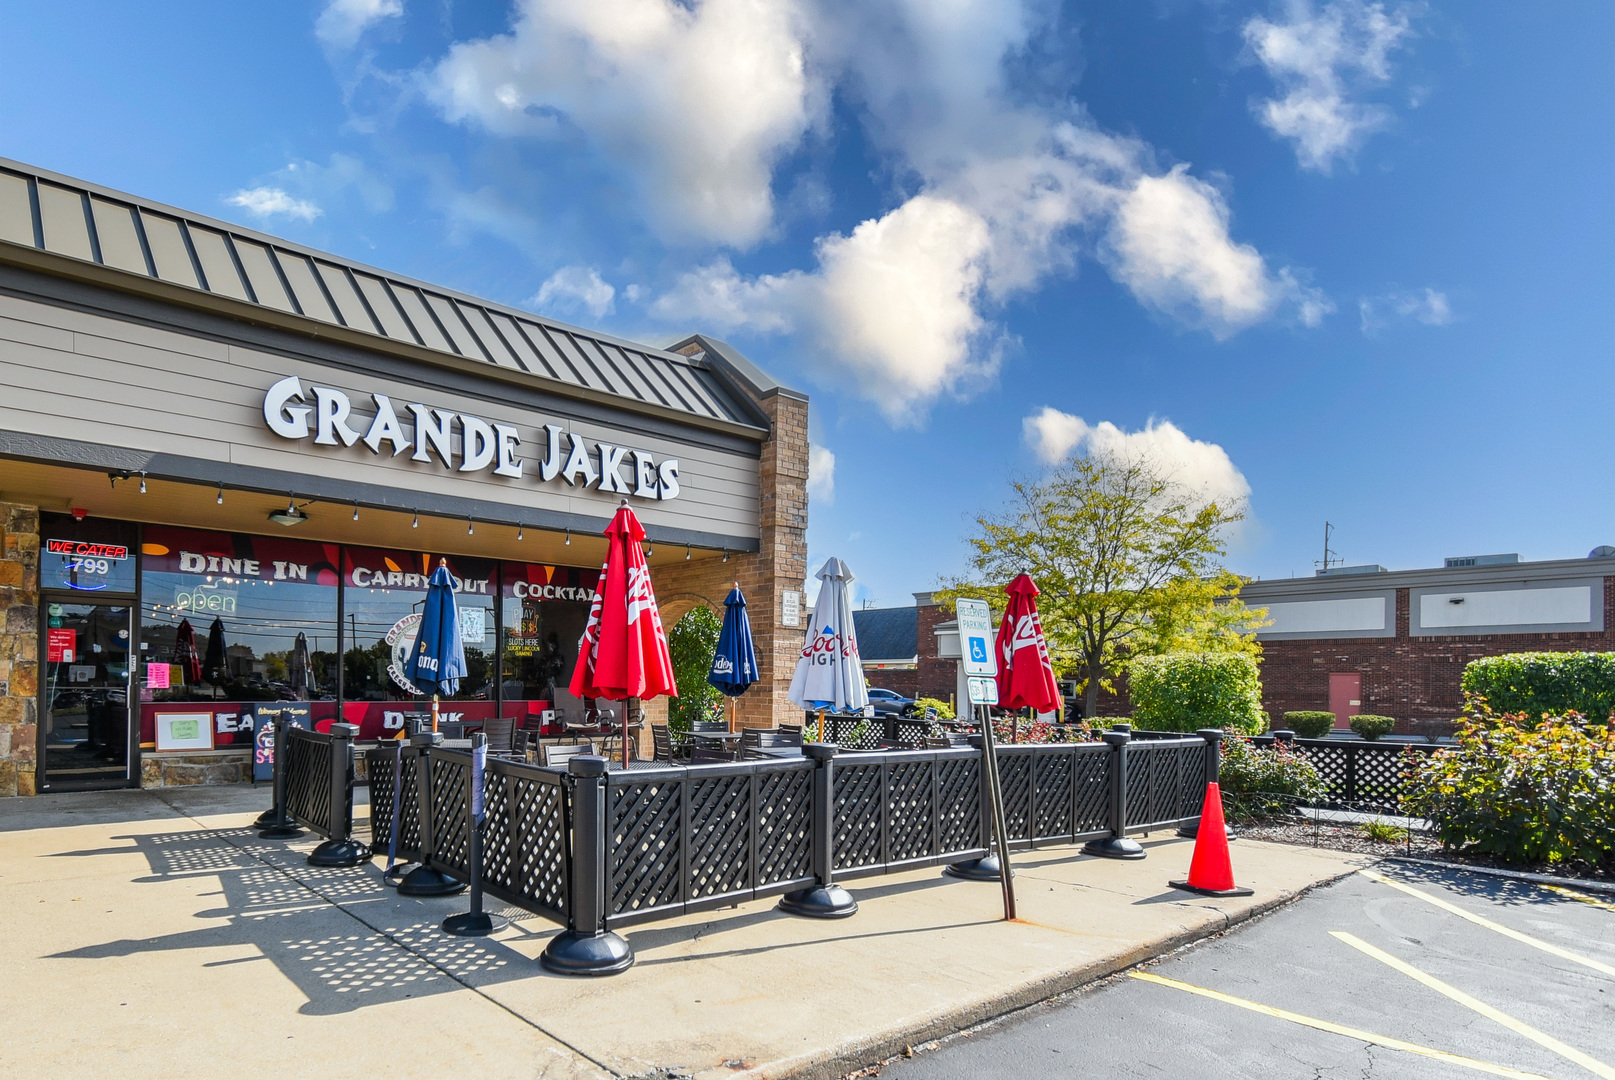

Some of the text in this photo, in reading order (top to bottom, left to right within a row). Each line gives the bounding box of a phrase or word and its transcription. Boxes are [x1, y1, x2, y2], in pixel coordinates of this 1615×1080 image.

[263, 375, 680, 500] GRANDE JAKES
[50, 541, 126, 558] WE CATER
[71, 558, 109, 575] 799
[179, 551, 308, 580] DINE IN
[352, 567, 489, 594] CARRY OUT
[512, 580, 595, 602] COCKTAI
[176, 592, 236, 614] open
[514, 608, 533, 619] PLAY
[959, 606, 987, 619] RESERVED
[962, 620, 988, 632] PARKING
[508, 638, 539, 647] SLOTS HERE
[417, 655, 439, 673] ona
[216, 713, 254, 733] EA
